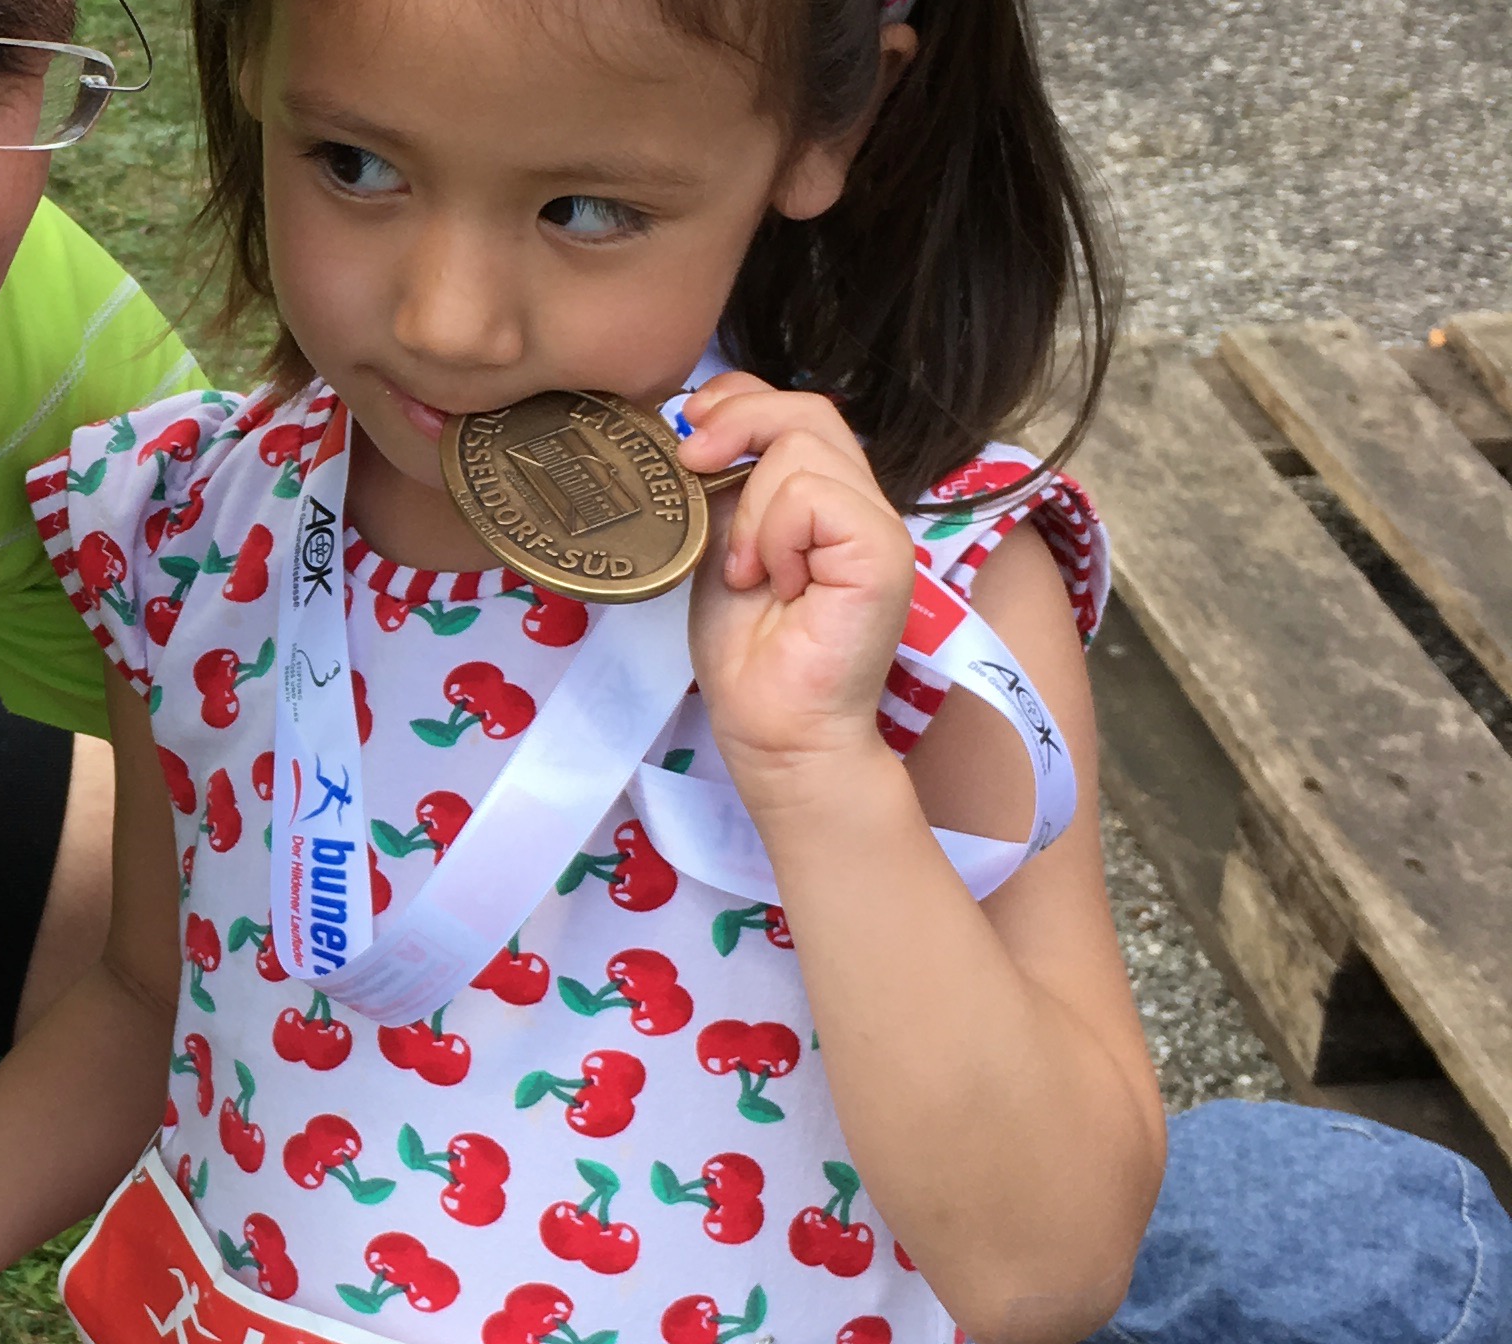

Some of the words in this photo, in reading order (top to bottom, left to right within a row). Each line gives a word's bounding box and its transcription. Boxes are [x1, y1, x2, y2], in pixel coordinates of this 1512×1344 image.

[302, 495, 337, 607] AOK
[291, 834, 305, 859] Der
[290, 860, 304, 913] Hildener
